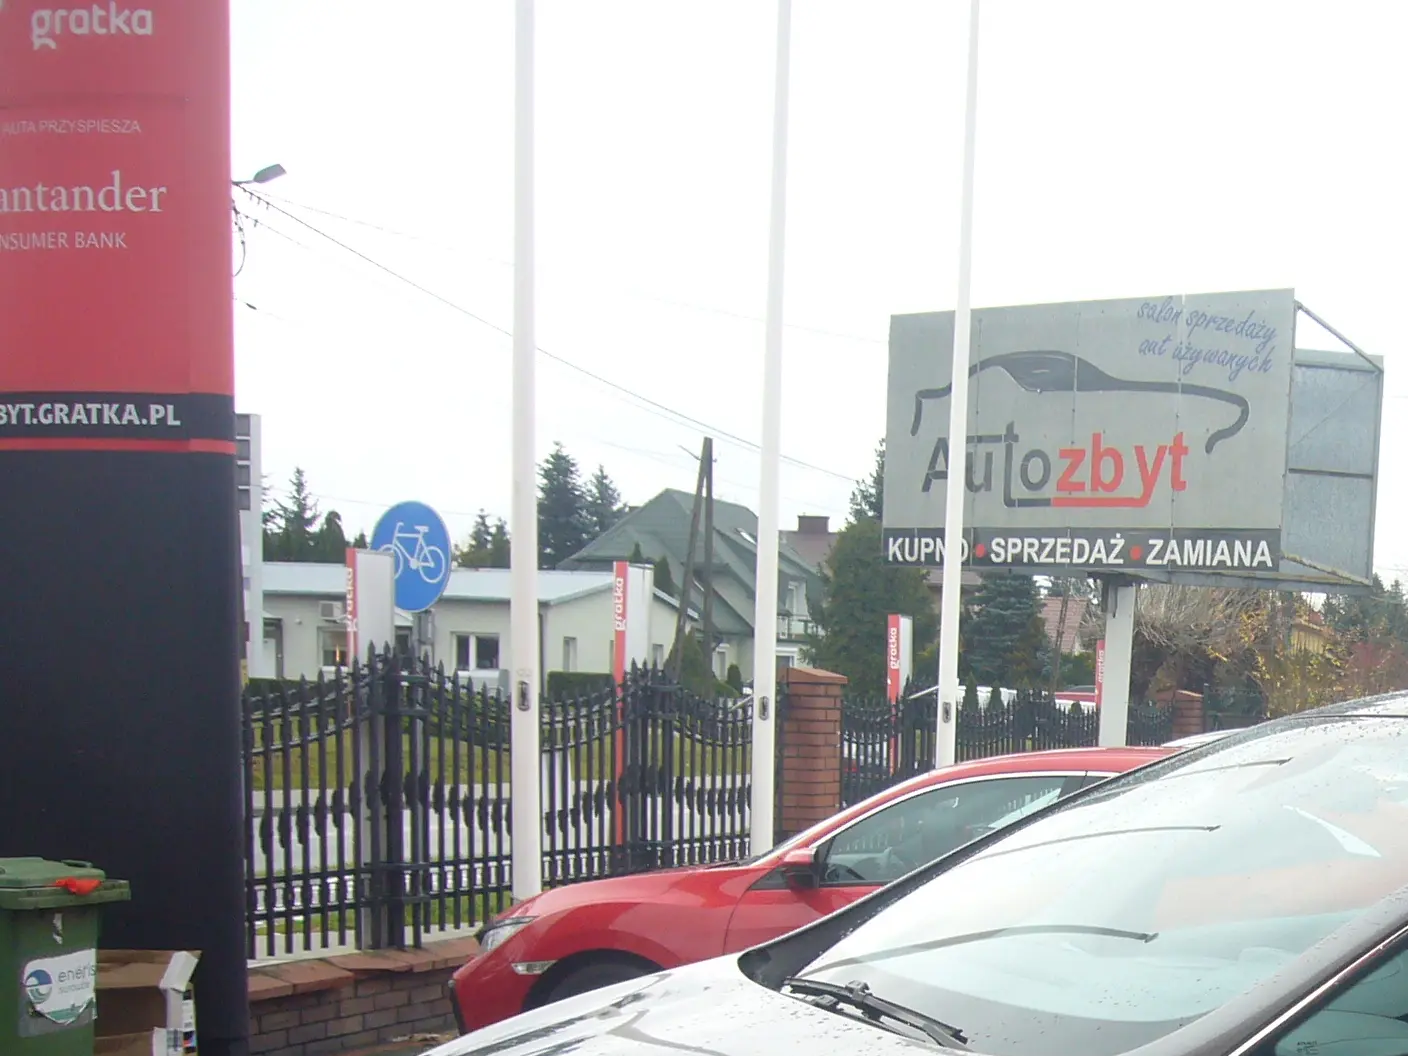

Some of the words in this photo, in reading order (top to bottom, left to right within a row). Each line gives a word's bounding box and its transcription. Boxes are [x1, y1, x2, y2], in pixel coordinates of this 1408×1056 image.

[31, 1, 154, 50] gratka
[39, 119, 142, 134] PRZYSPIESZA
[75, 231, 128, 249] BANK
[1137, 296, 1183, 324] salon
[921, 420, 1189, 508] Autozbyt
[990, 533, 1126, 564] SPRZEDAŻ
[1145, 539, 1273, 568] ZAMIANA
